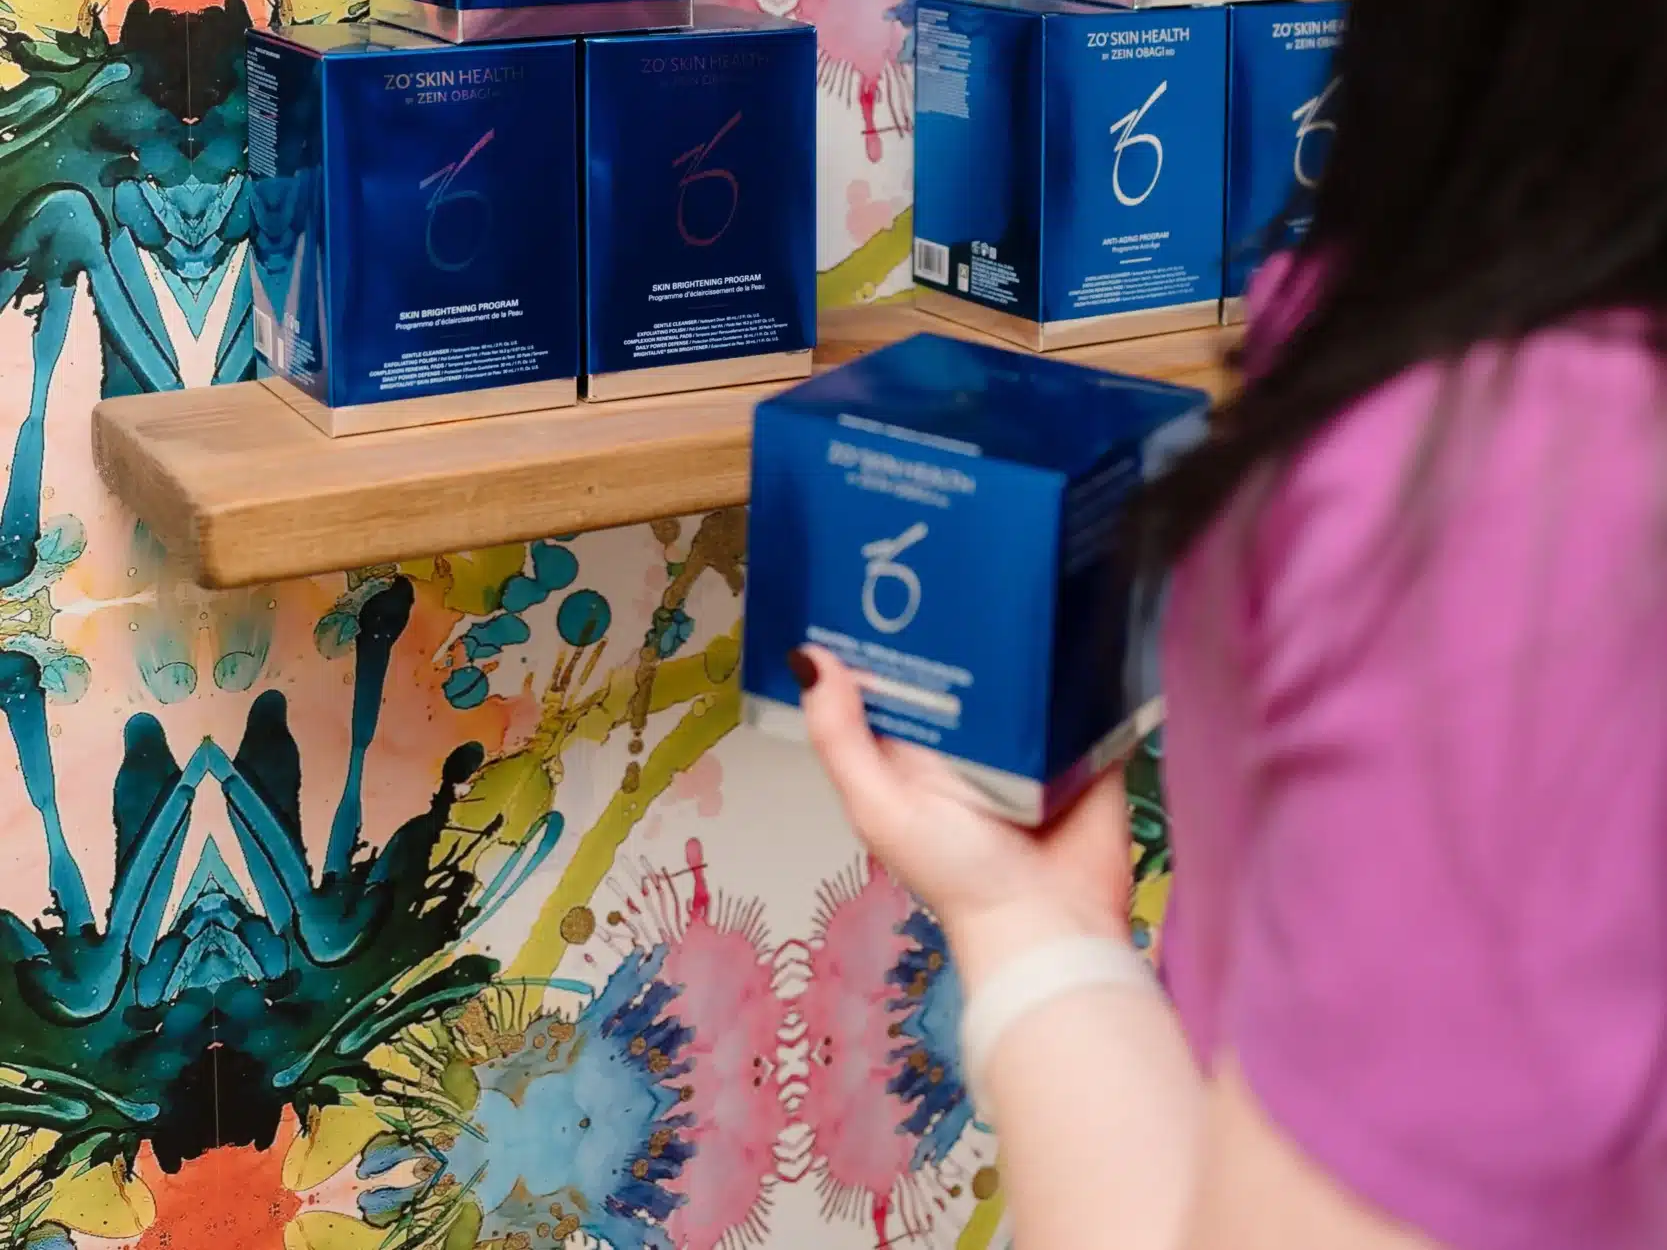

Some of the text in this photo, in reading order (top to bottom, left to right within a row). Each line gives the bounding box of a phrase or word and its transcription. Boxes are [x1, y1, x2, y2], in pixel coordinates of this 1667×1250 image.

[1110, 30, 1138, 46] SKIN
[1142, 27, 1189, 43] HEALTH
[1294, 21, 1321, 36] SKIN
[1111, 48, 1133, 60] ZEIN
[1135, 46, 1164, 58] OBAGI
[416, 71, 454, 88] SKIN
[460, 66, 524, 85] HEALTH
[418, 91, 447, 104] ZEIN
[652, 274, 761, 292] SKIN BRIGHTENING PROGRAM
[648, 292, 683, 302] Programme
[400, 299, 519, 320] SKIN BRIGHTENING PROGRAM
[395, 320, 433, 330] Programme
[508, 309, 523, 317] Peau
